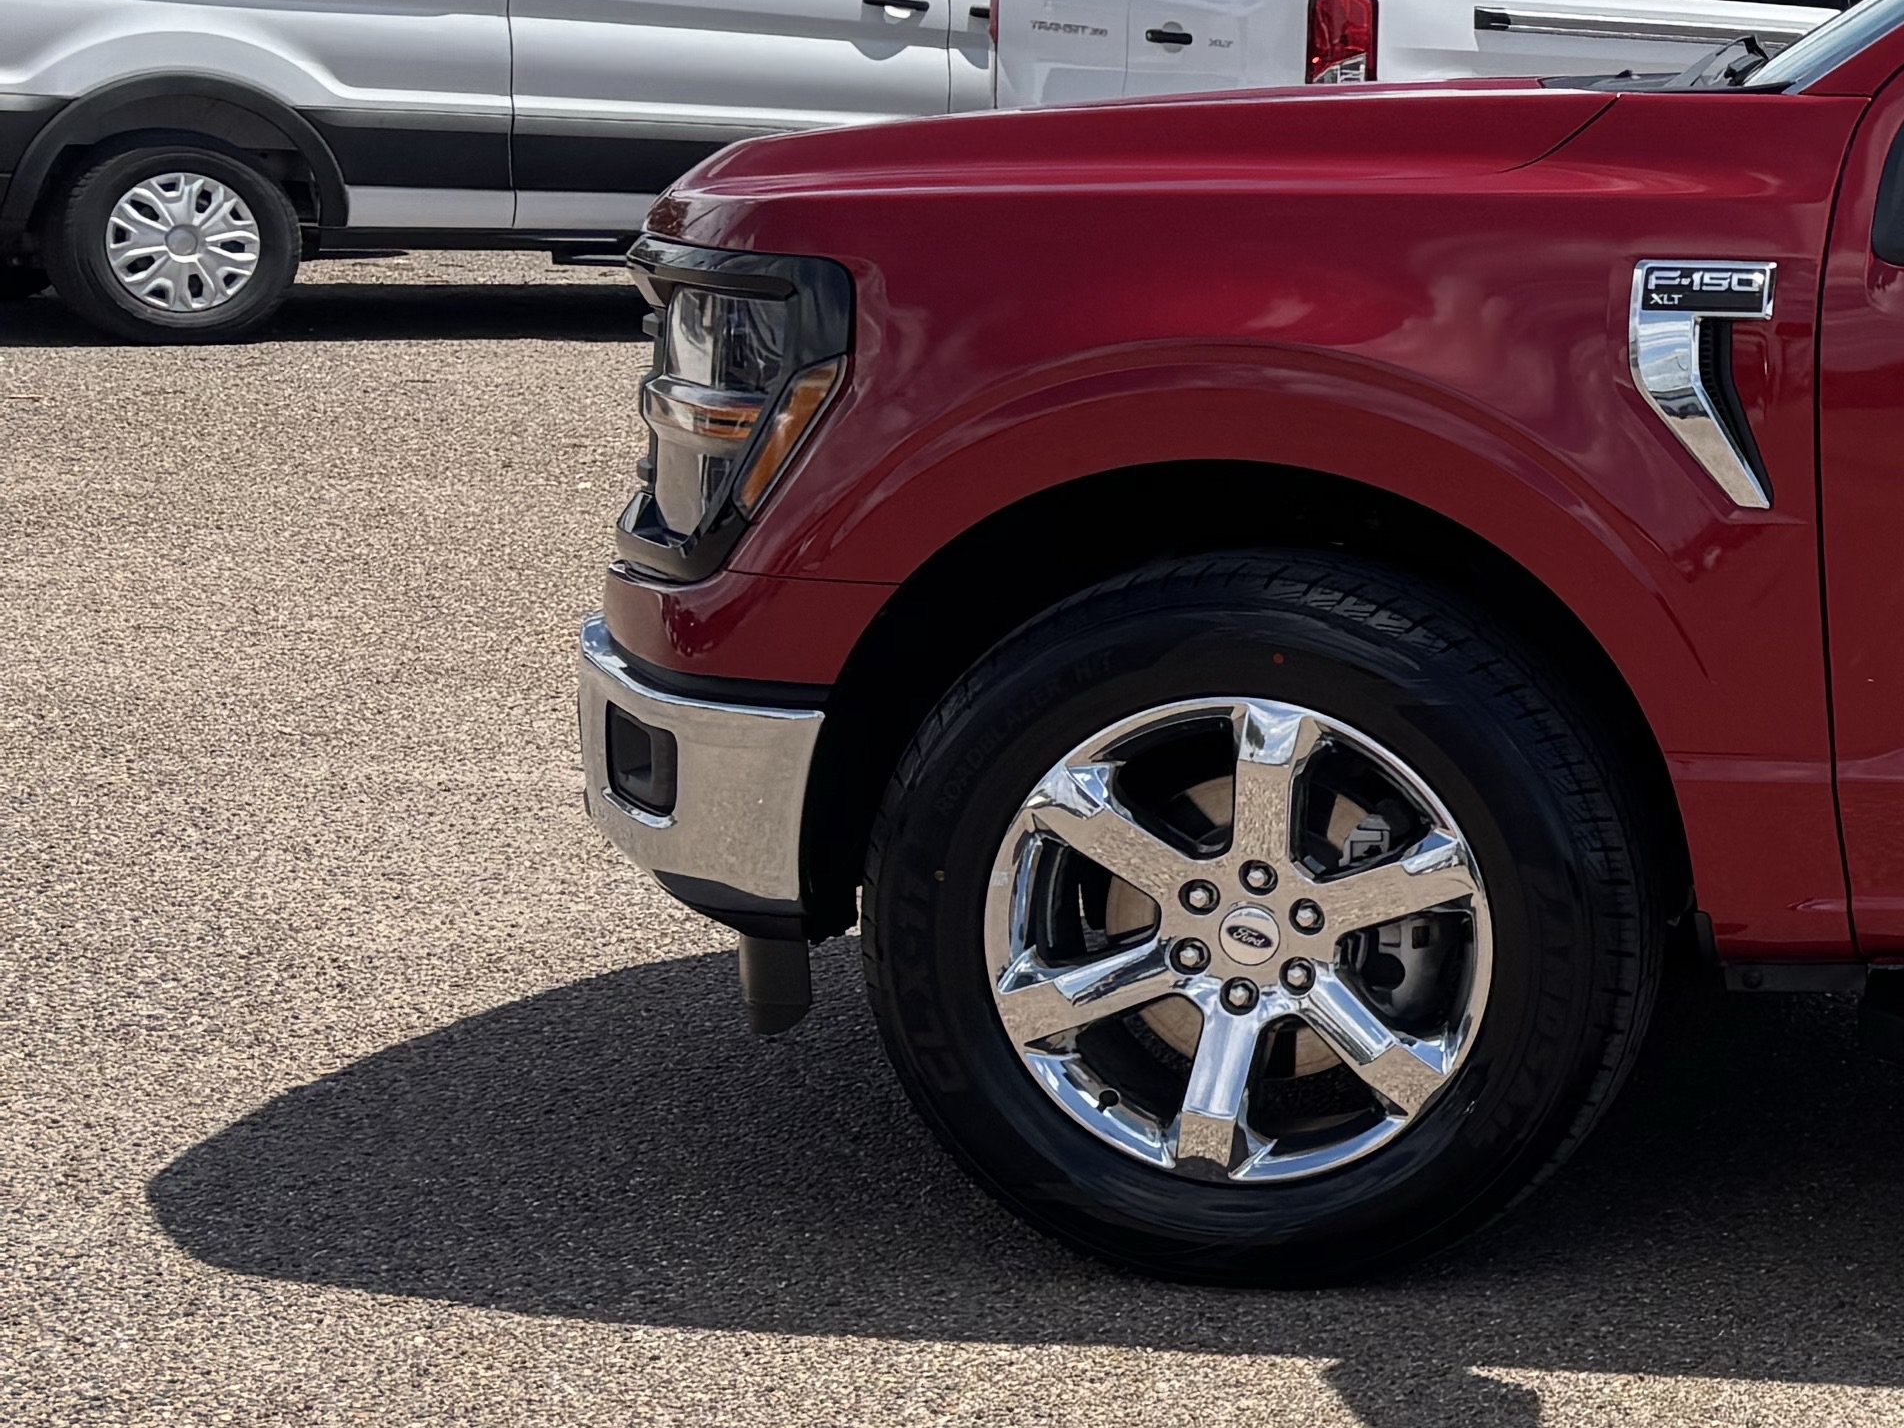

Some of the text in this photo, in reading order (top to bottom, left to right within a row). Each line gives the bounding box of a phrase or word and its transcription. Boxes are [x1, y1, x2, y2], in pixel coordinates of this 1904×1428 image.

[1647, 270, 1765, 292] F-150
[1650, 293, 1683, 305] XLT
[1233, 927, 1265, 947] Ford
